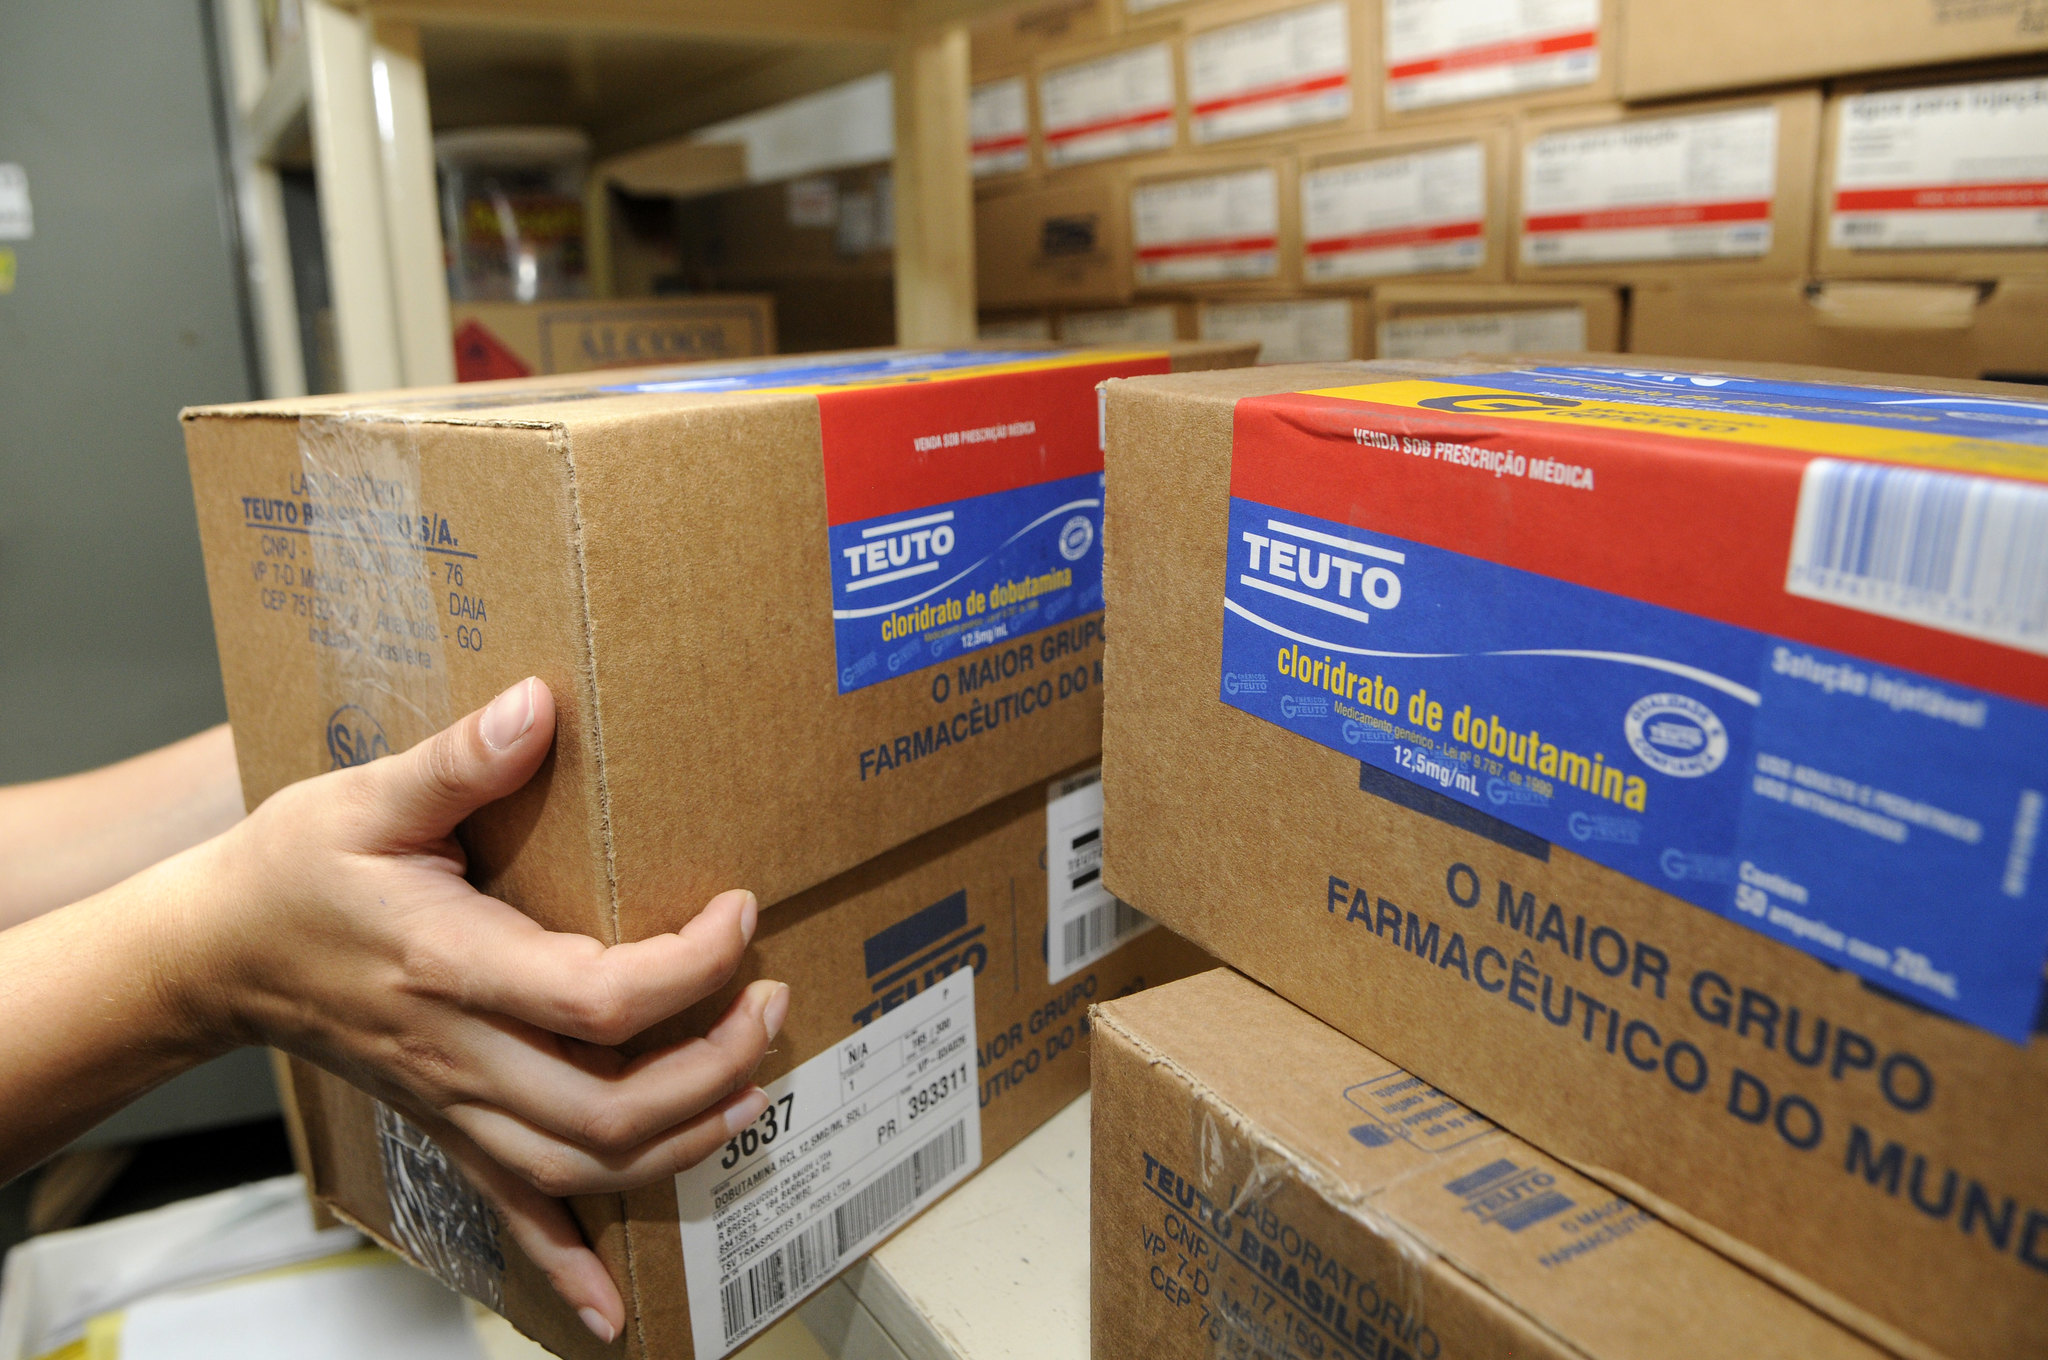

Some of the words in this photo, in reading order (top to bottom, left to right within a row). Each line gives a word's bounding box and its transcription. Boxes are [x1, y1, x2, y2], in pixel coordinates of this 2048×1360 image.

[1353, 427, 1400, 453] VENDA
[1402, 436, 1430, 459] SOB
[1434, 441, 1528, 479] PRESCRIÇÃO
[1529, 456, 1595, 492] MÉDICA
[241, 497, 298, 525] TEUTO
[444, 561, 464, 587] 76
[843, 524, 955, 577] TEUTO
[1242, 530, 1403, 611] TEUTO
[449, 591, 488, 623] DAIA
[881, 600, 963, 643] cloridrato
[965, 589, 987, 617] de
[989, 566, 1073, 608] dobutamina
[456, 624, 483, 653] GO
[932, 672, 950, 704] O
[957, 643, 1034, 697] MAIOR
[859, 680, 1054, 782] FARMACÊUTICO
[1059, 665, 1089, 700] DO
[1277, 644, 1400, 716] cloridrato
[1408, 688, 1443, 733] de
[1452, 704, 1648, 814] dobutamina
[1333, 700, 1395, 735] Medicamento
[1394, 724, 1434, 751] genérico
[1393, 744, 1481, 798] 12,5mg/mL
[1028, 974, 1098, 1036] GRUPO
[1445, 862, 1481, 908] O
[1496, 881, 1671, 1001] MAIOR
[1689, 970, 1936, 1115] GRUPO
[1045, 1022, 1075, 1062] DO
[908, 1062, 968, 1121] 393311
[1328, 875, 1709, 1094] FARMACÊUTICO
[1726, 1069, 1824, 1152] DO
[1843, 1122, 2048, 1275] MUND
[877, 1118, 897, 1146] PR
[714, 1162, 777, 1210] DOBUTAMINA
[1460, 1172, 1558, 1219] TEUTO
[1141, 1223, 1167, 1256] VP
[1176, 1252, 1210, 1297] 7-D
[1142, 1150, 1233, 1241] TEUTO
[1239, 1228, 1415, 1360] BRASILEI
[1164, 1212, 1221, 1274] CNPJ
[1150, 1265, 1191, 1308] CEP
